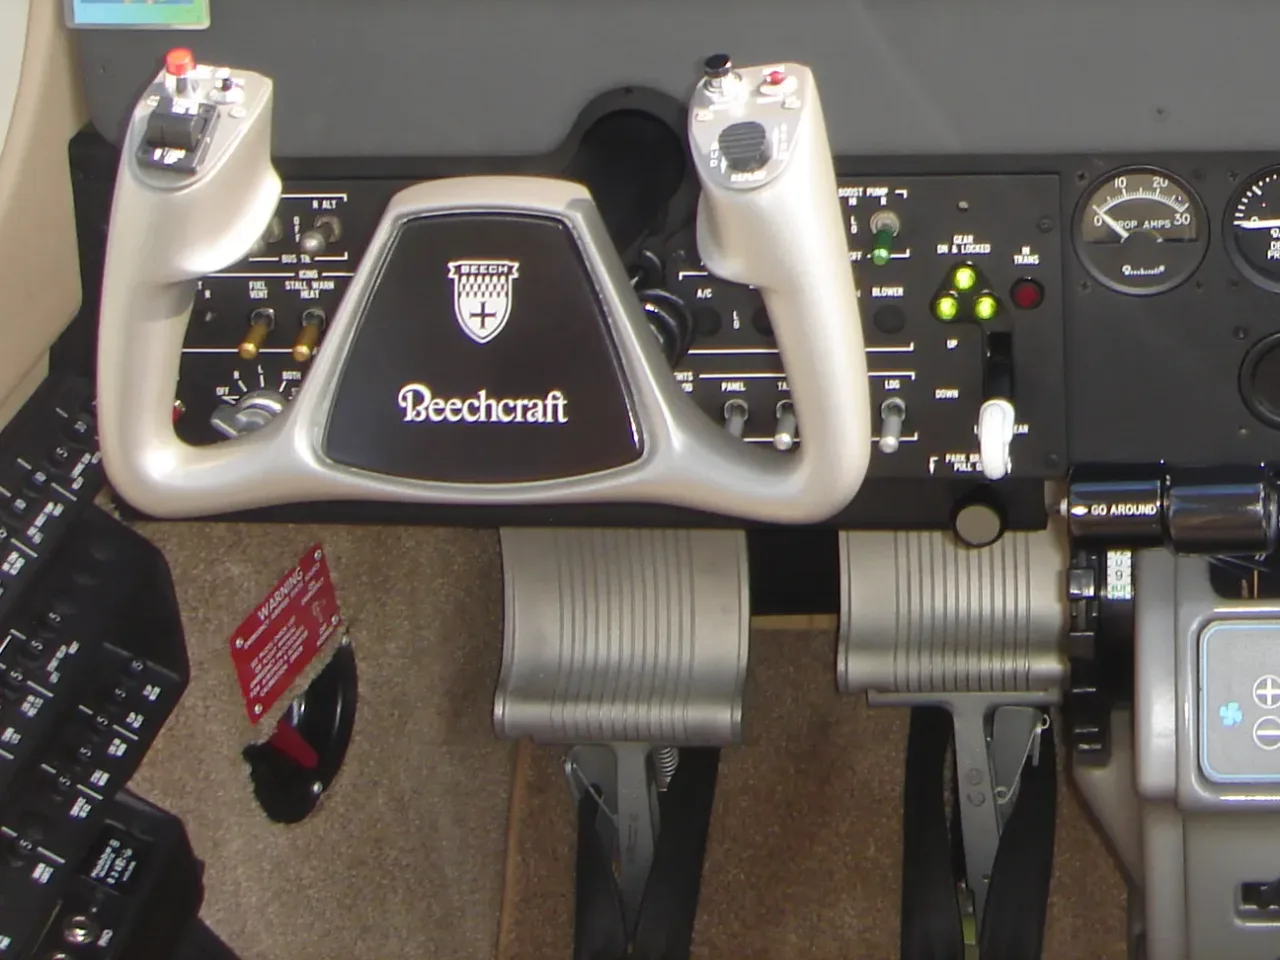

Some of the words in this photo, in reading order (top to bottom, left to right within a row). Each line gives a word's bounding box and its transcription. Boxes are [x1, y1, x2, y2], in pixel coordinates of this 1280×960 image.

[1114, 178, 1126, 188] 10
[1152, 178, 1168, 188] 20
[322, 200, 337, 209] ALT
[1094, 216, 1102, 226] 0
[1143, 220, 1170, 229] AMPS
[1174, 214, 1190, 225] 30
[961, 245, 991, 254] LOCKED
[461, 265, 508, 273] BEECH
[872, 288, 903, 297] BLOWER
[721, 383, 745, 392] PANEL
[398, 383, 568, 423] Beechcraft
[1091, 504, 1108, 516] GO
[1110, 504, 1156, 516] AROUND
[257, 566, 304, 621] WARNING
